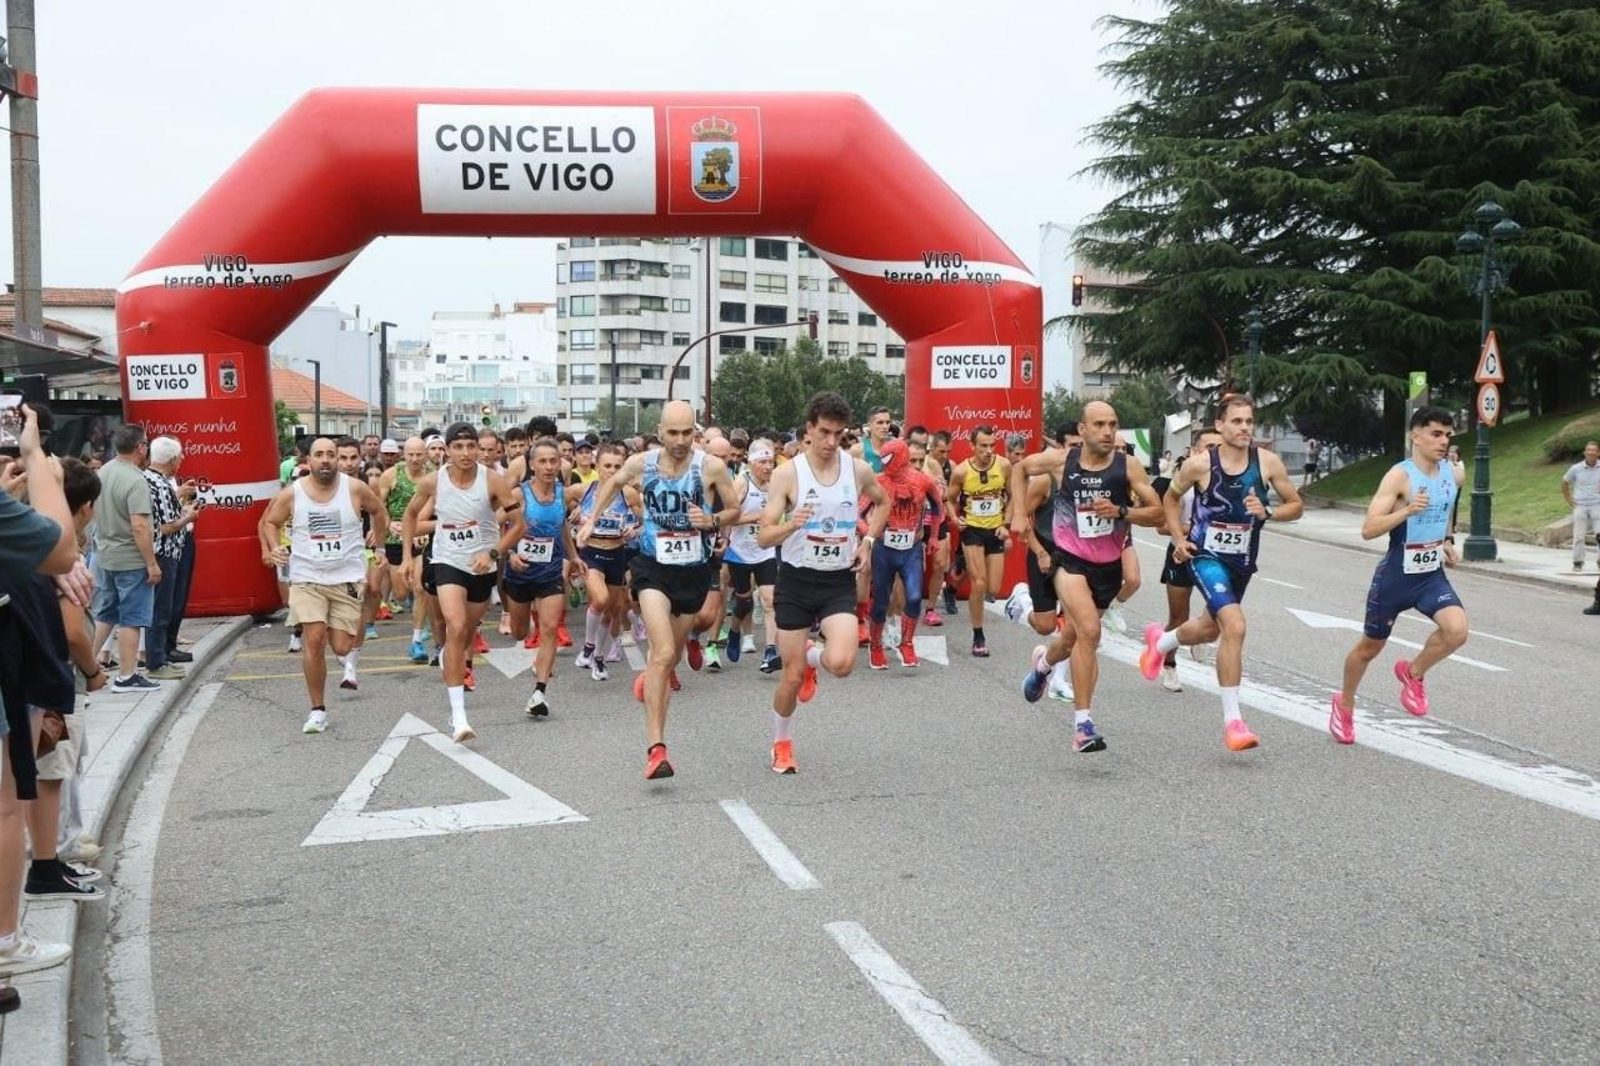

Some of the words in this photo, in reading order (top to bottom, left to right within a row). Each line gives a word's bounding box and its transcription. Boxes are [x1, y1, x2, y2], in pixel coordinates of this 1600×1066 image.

[435, 124, 636, 154] CONCELLO
[461, 162, 510, 191] DE
[523, 163, 614, 192] VIGO
[203, 255, 254, 274] VIGO,
[922, 252, 968, 270] VIGO,
[164, 275, 215, 289] terreo
[223, 273, 245, 288] de
[252, 274, 293, 289] xogo
[884, 269, 933, 284] terreo
[940, 269, 960, 284] de
[966, 271, 1001, 286] xogo
[936, 354, 1005, 366] CONCELLO
[130, 363, 197, 376] CONCELLO
[943, 368, 960, 379] DE
[965, 368, 998, 379] VIGO
[137, 379, 150, 391] DE
[155, 378, 189, 390] VIGO
[1484, 397, 1495, 411] 30
[945, 405, 996, 420] Vivimos
[1001, 405, 1032, 419] nunha
[140, 419, 188, 434] Vivimos
[194, 417, 237, 433] nunha
[185, 439, 241, 455] fermosa
[215, 494, 253, 508] xogo
[980, 501, 992, 511] 67
[1086, 515, 1110, 527] 17
[450, 530, 474, 542] 444
[890, 534, 908, 543] 271
[1214, 531, 1242, 545] 425
[317, 541, 341, 552] 114
[524, 543, 546, 554] 228
[664, 540, 691, 553] 241
[813, 545, 840, 557] 154
[1413, 551, 1437, 565] 462
